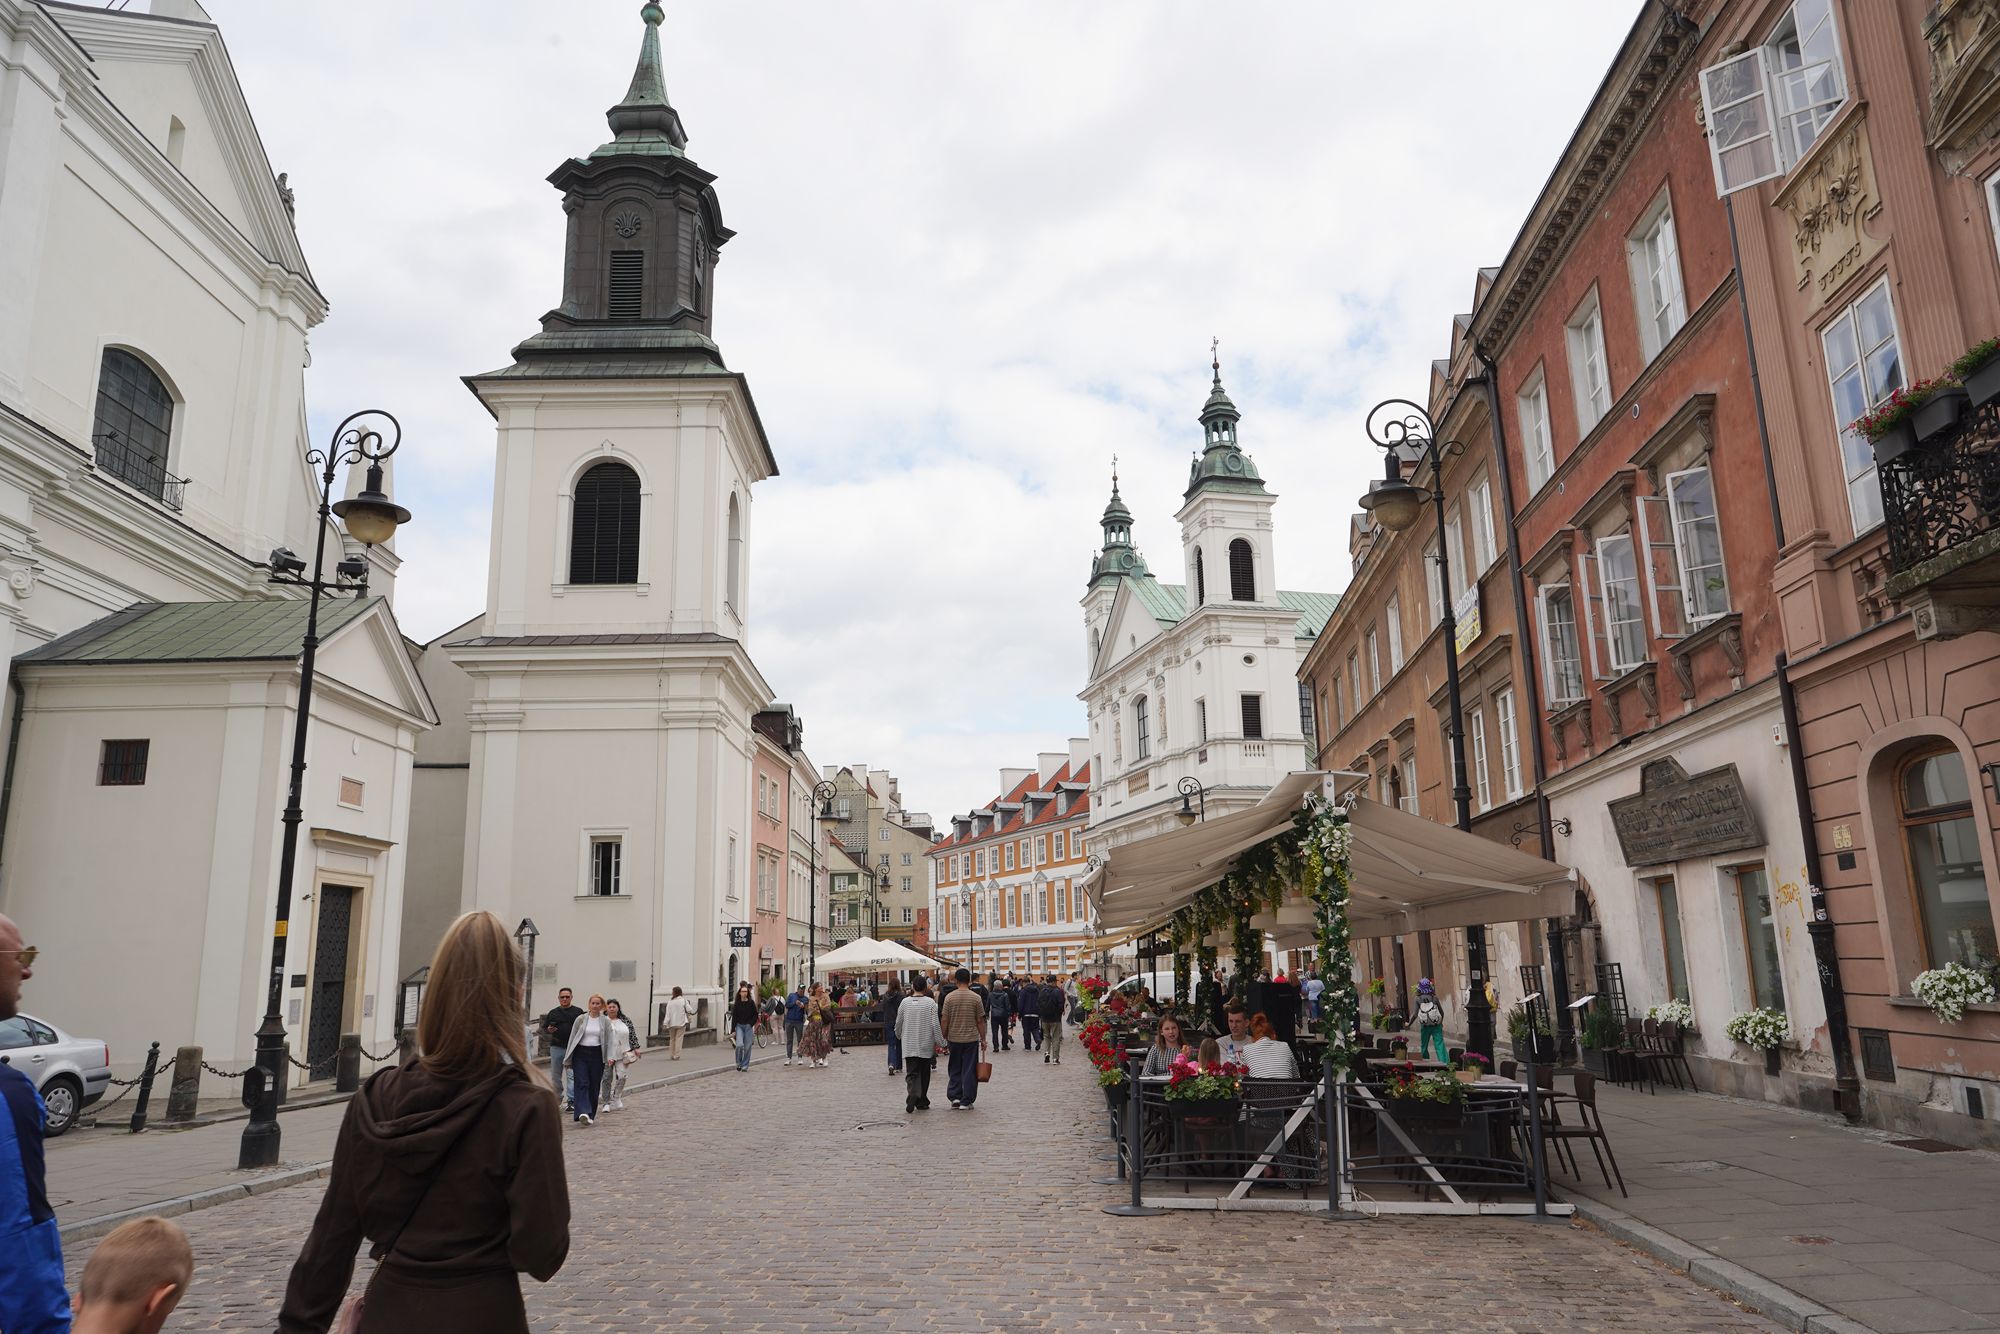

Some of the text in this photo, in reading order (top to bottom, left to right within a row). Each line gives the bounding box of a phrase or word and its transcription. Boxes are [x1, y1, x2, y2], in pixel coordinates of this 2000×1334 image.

[1621, 785, 1738, 833] POD SAMSONEM
[1696, 820, 1745, 840] RESTAURANT
[870, 957, 893, 965] PEPSI
